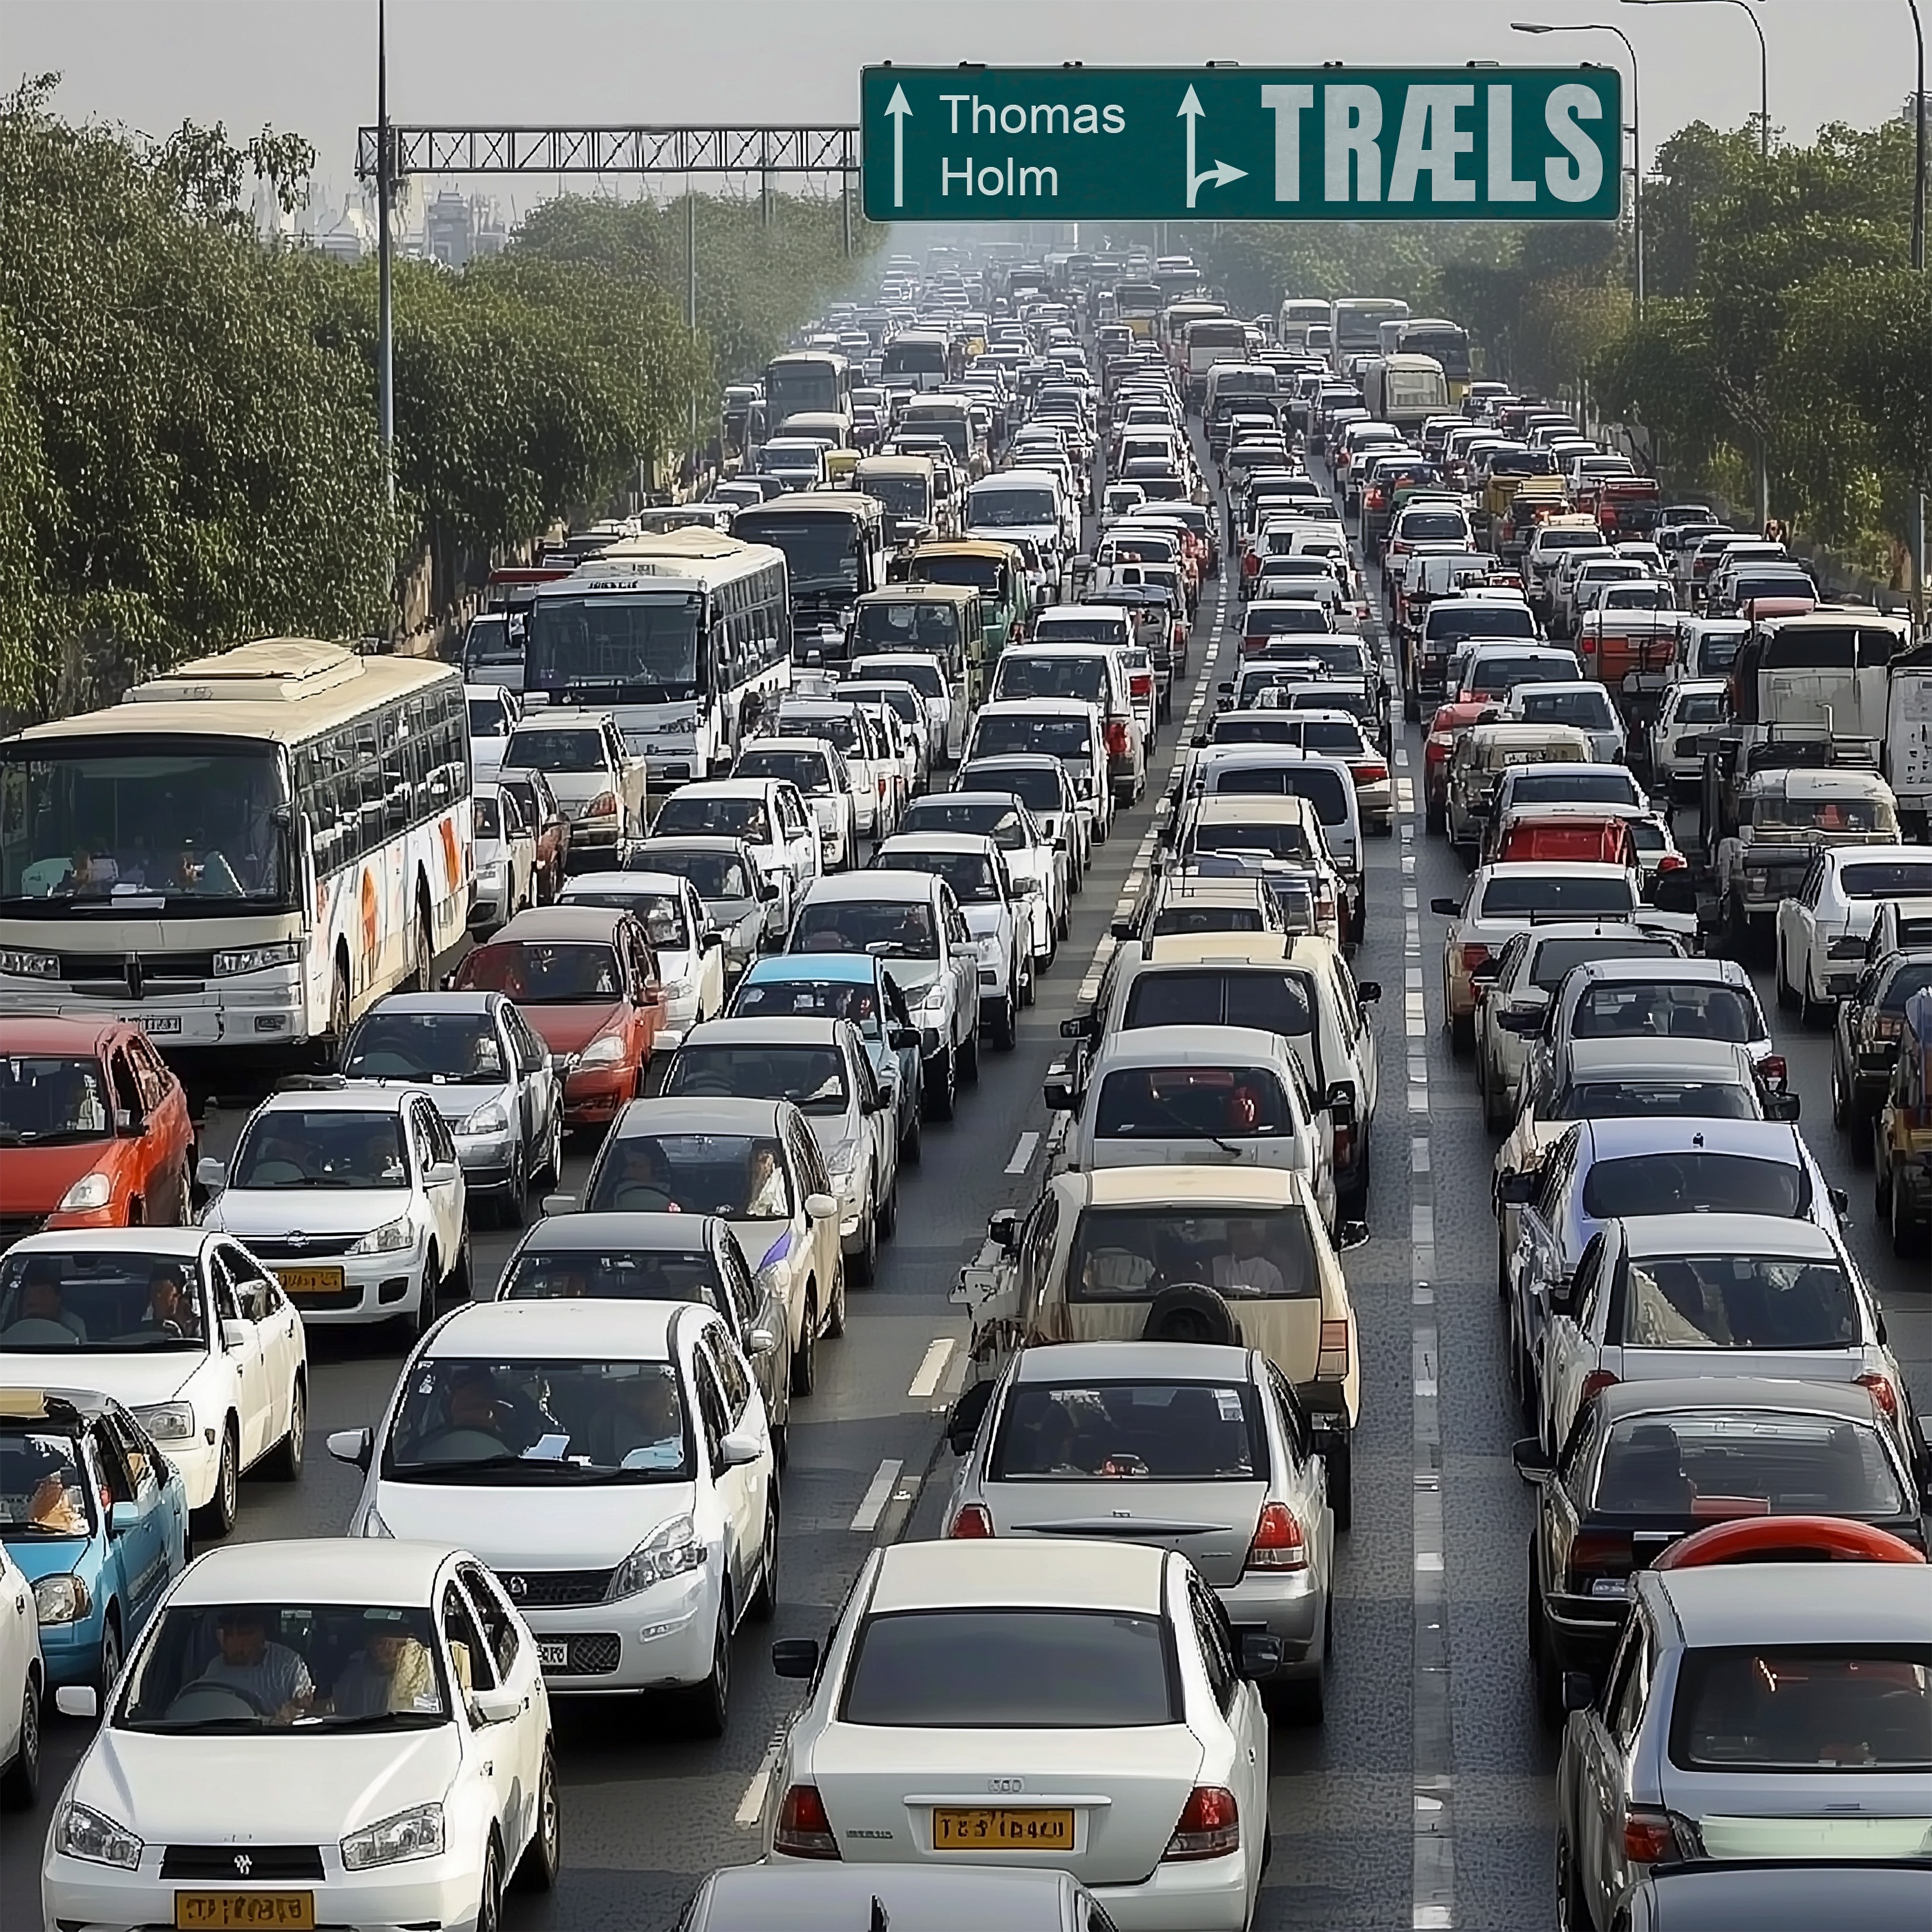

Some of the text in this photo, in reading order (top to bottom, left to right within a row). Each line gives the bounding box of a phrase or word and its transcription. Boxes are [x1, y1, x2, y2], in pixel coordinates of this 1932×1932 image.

[940, 95, 1126, 134] Thomas
[1261, 84, 1604, 202] TRÆLS
[942, 157, 1057, 196] Holm
